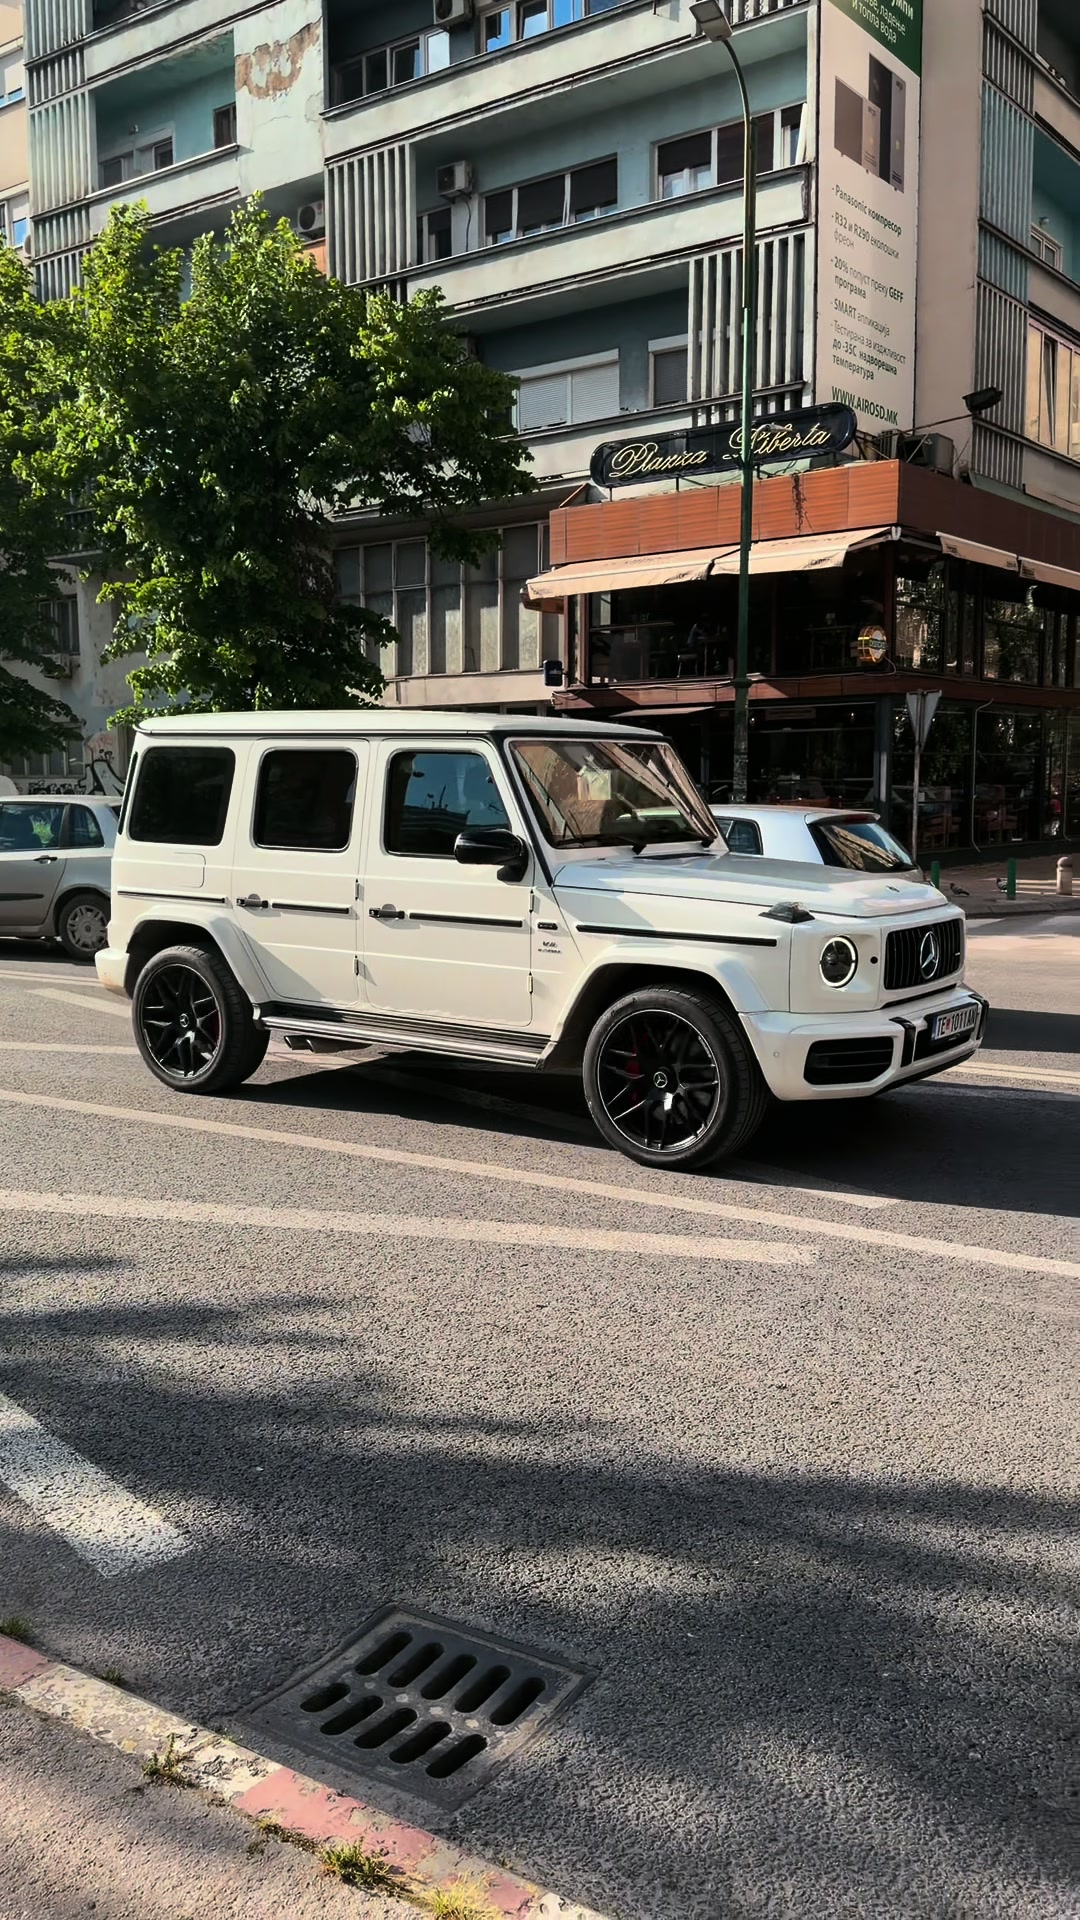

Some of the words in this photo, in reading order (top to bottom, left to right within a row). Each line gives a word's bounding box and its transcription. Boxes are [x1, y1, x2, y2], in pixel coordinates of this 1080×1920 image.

[859, 2, 880, 29] топла
[880, 21, 897, 43] вода
[835, 184, 868, 215] Panasonic
[868, 207, 902, 237] компресор
[835, 212, 848, 229] R32
[854, 223, 871, 242] R290
[834, 228, 855, 249] фреон
[834, 256, 849, 274] 20%
[888, 286, 904, 303] GEFF
[834, 275, 867, 299] програма
[834, 298, 857, 320] SMART
[832, 338, 842, 351] до
[859, 350, 898, 376] надворешна
[832, 354, 875, 381] температура
[831, 385, 899, 425] WWW.AIROSD.MK
